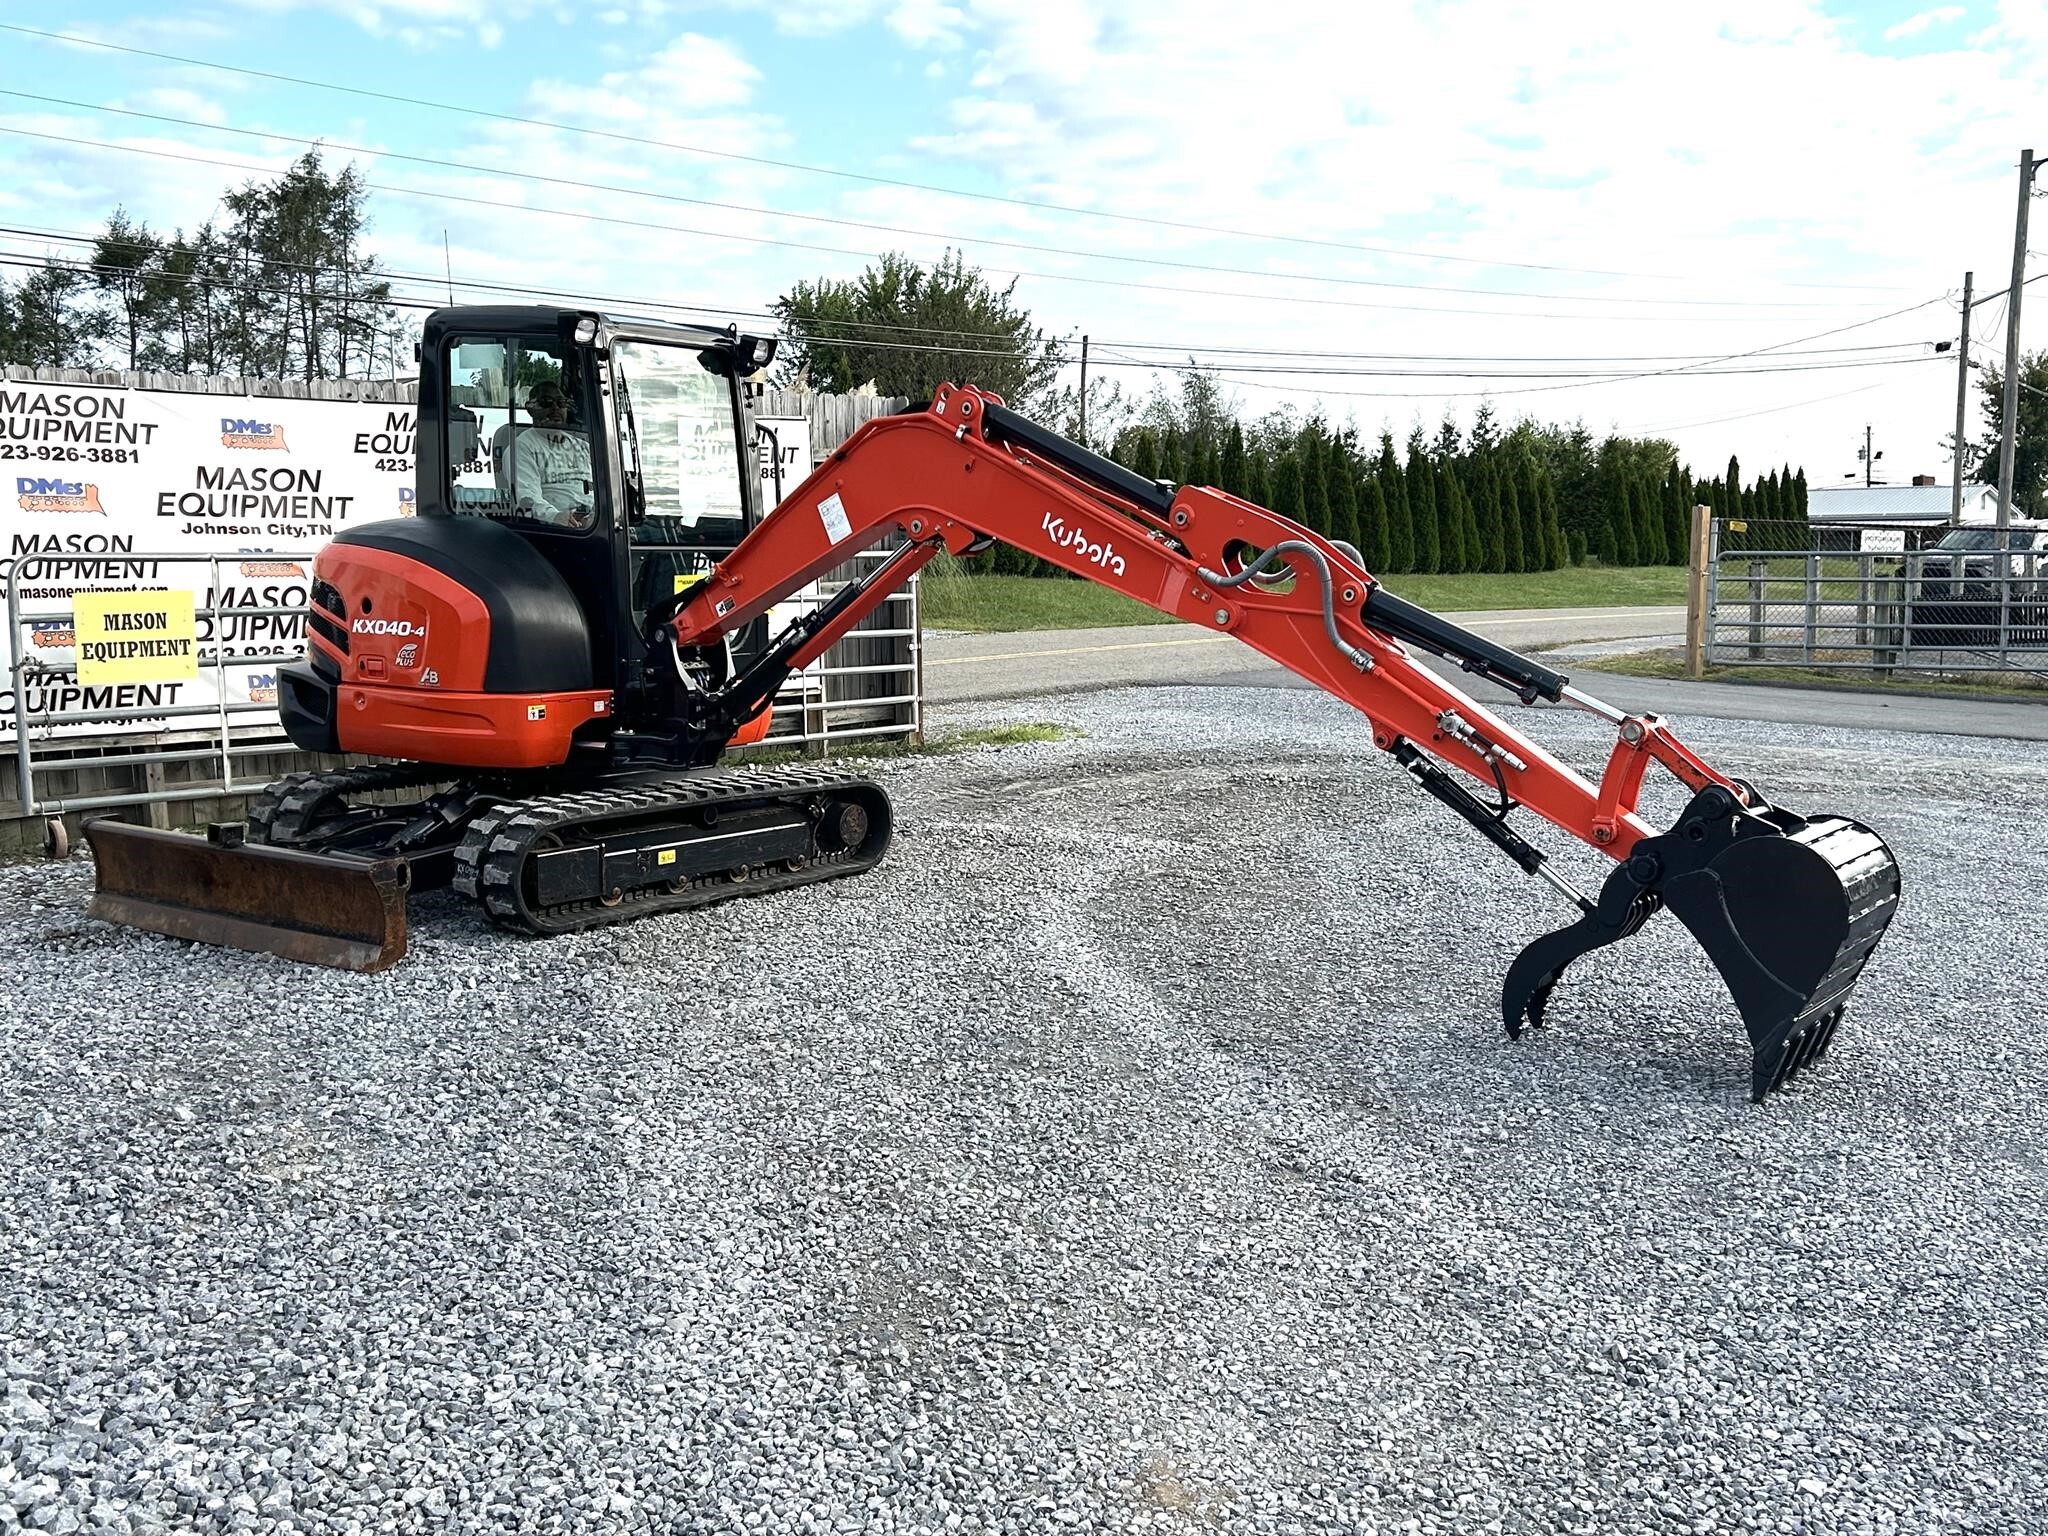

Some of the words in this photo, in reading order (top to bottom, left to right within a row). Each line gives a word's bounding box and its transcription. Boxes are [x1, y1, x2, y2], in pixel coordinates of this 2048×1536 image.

[0, 390, 125, 420] MASON
[196, 465, 322, 493] MASON
[157, 492, 355, 519] EQUIPMENT
[181, 522, 262, 535] Johnson
[12, 534, 133, 556] MASON
[1041, 511, 1127, 577] Kubota
[206, 586, 307, 608] MASO
[103, 612, 168, 631] MASON
[352, 618, 425, 637] KX040-4
[82, 638, 191, 663] EQUIPMENT
[395, 658, 415, 666] PLUS
